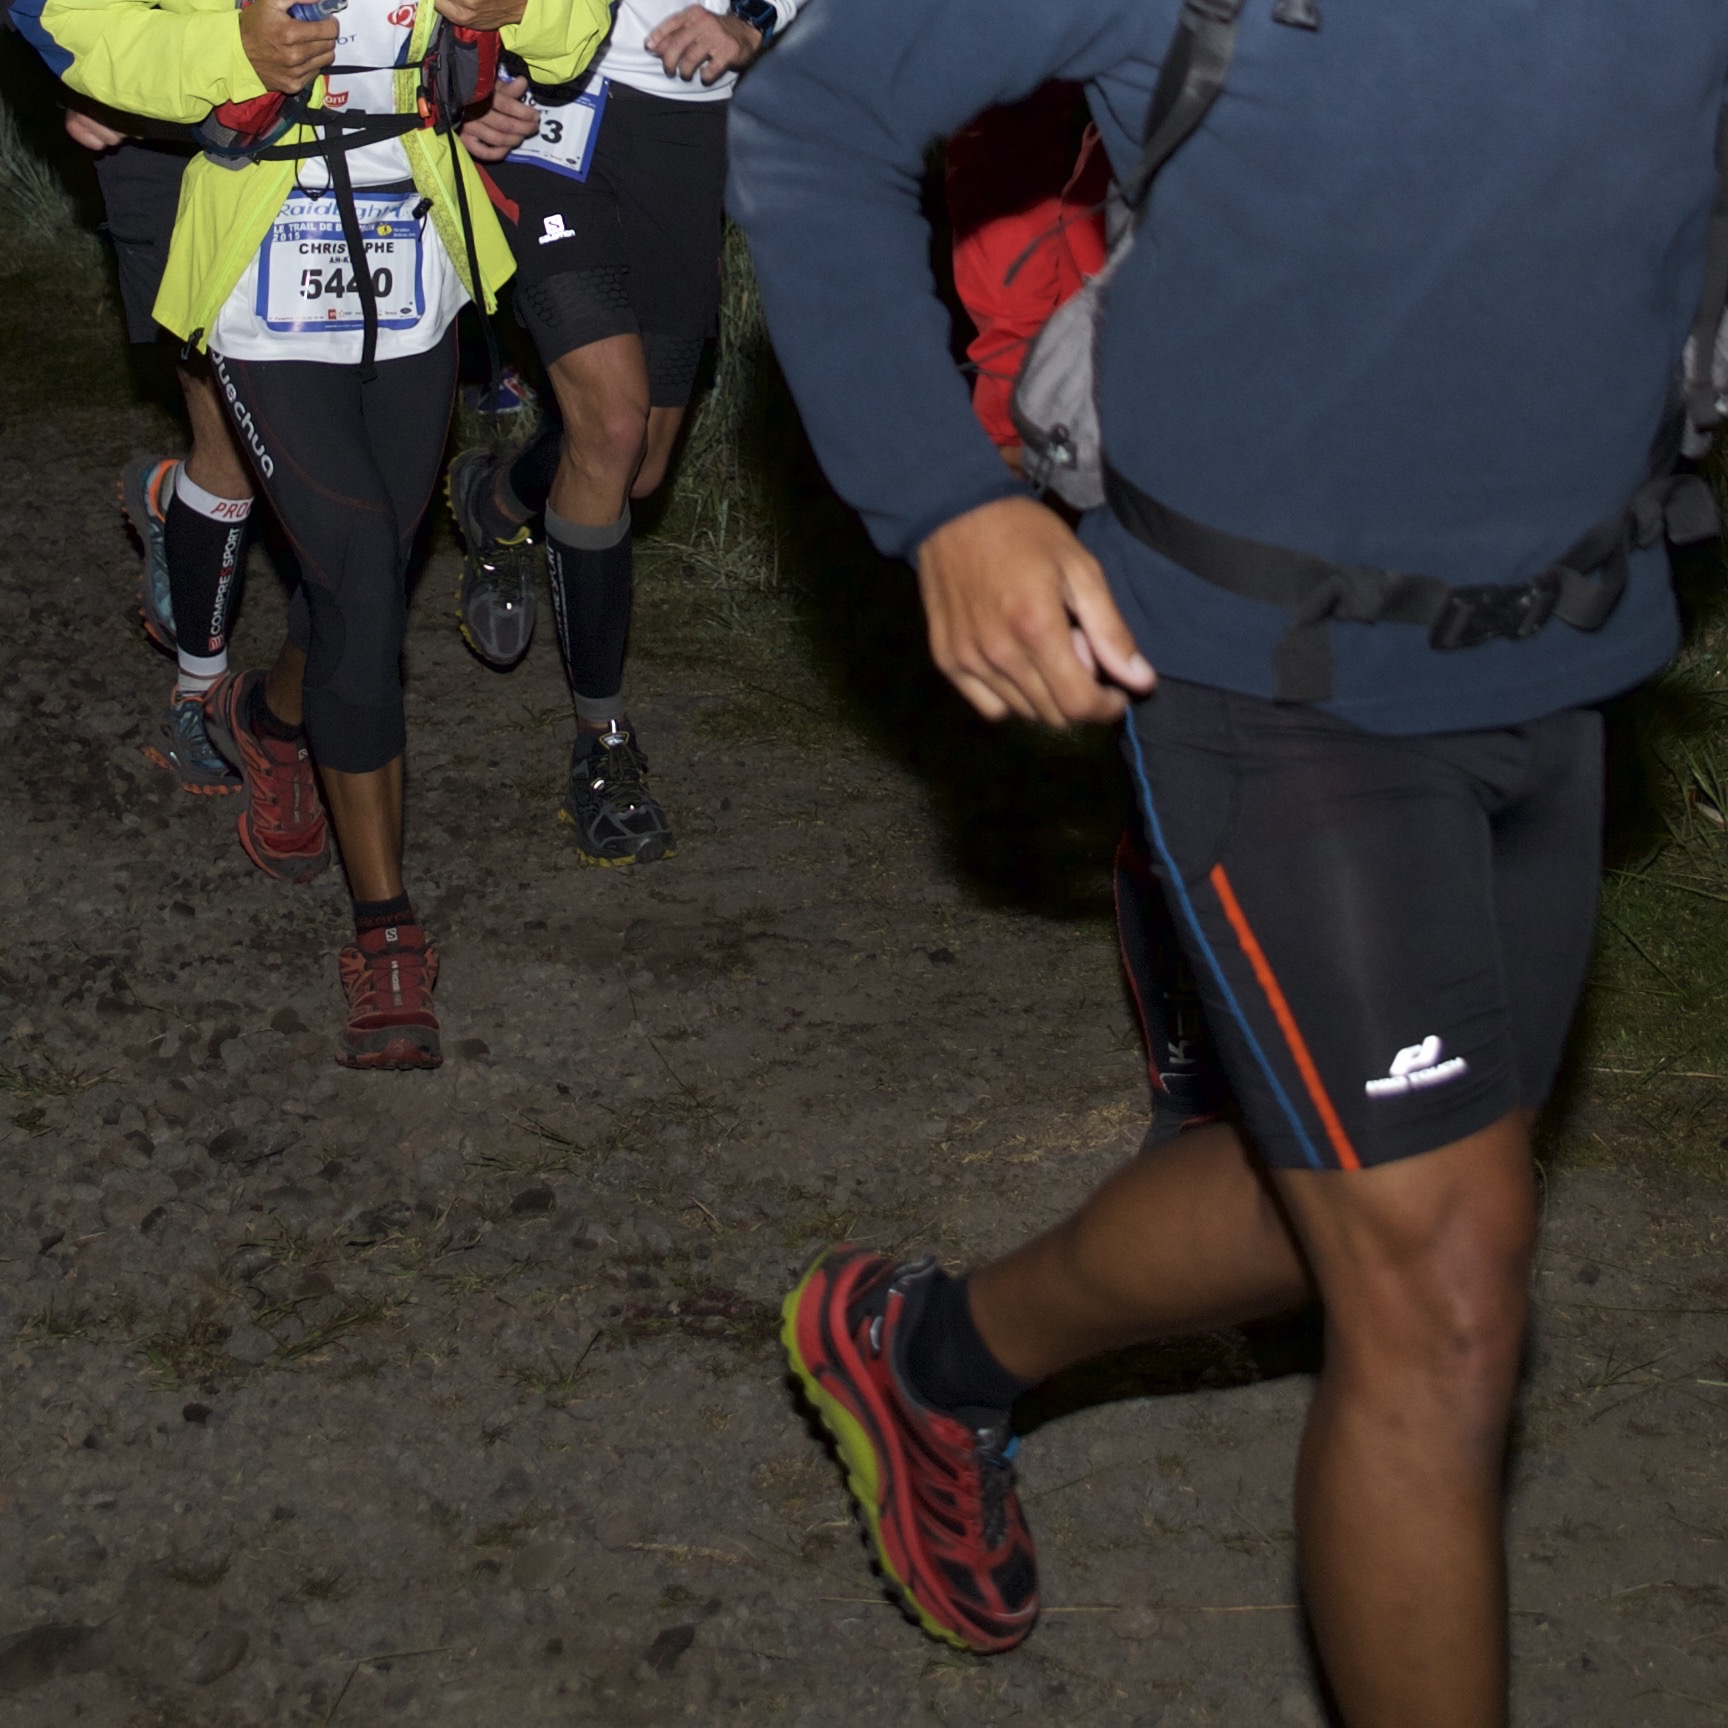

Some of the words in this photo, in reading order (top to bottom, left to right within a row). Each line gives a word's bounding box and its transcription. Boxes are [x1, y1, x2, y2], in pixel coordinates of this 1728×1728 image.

[276, 202, 390, 221] RaidLght
[274, 224, 284, 234] LE
[289, 222, 317, 232] TRAIL
[319, 222, 333, 232] DE
[273, 232, 300, 242] 2015
[299, 242, 394, 255] CHRISPHE
[210, 527, 240, 635] COMPRESSPORT
